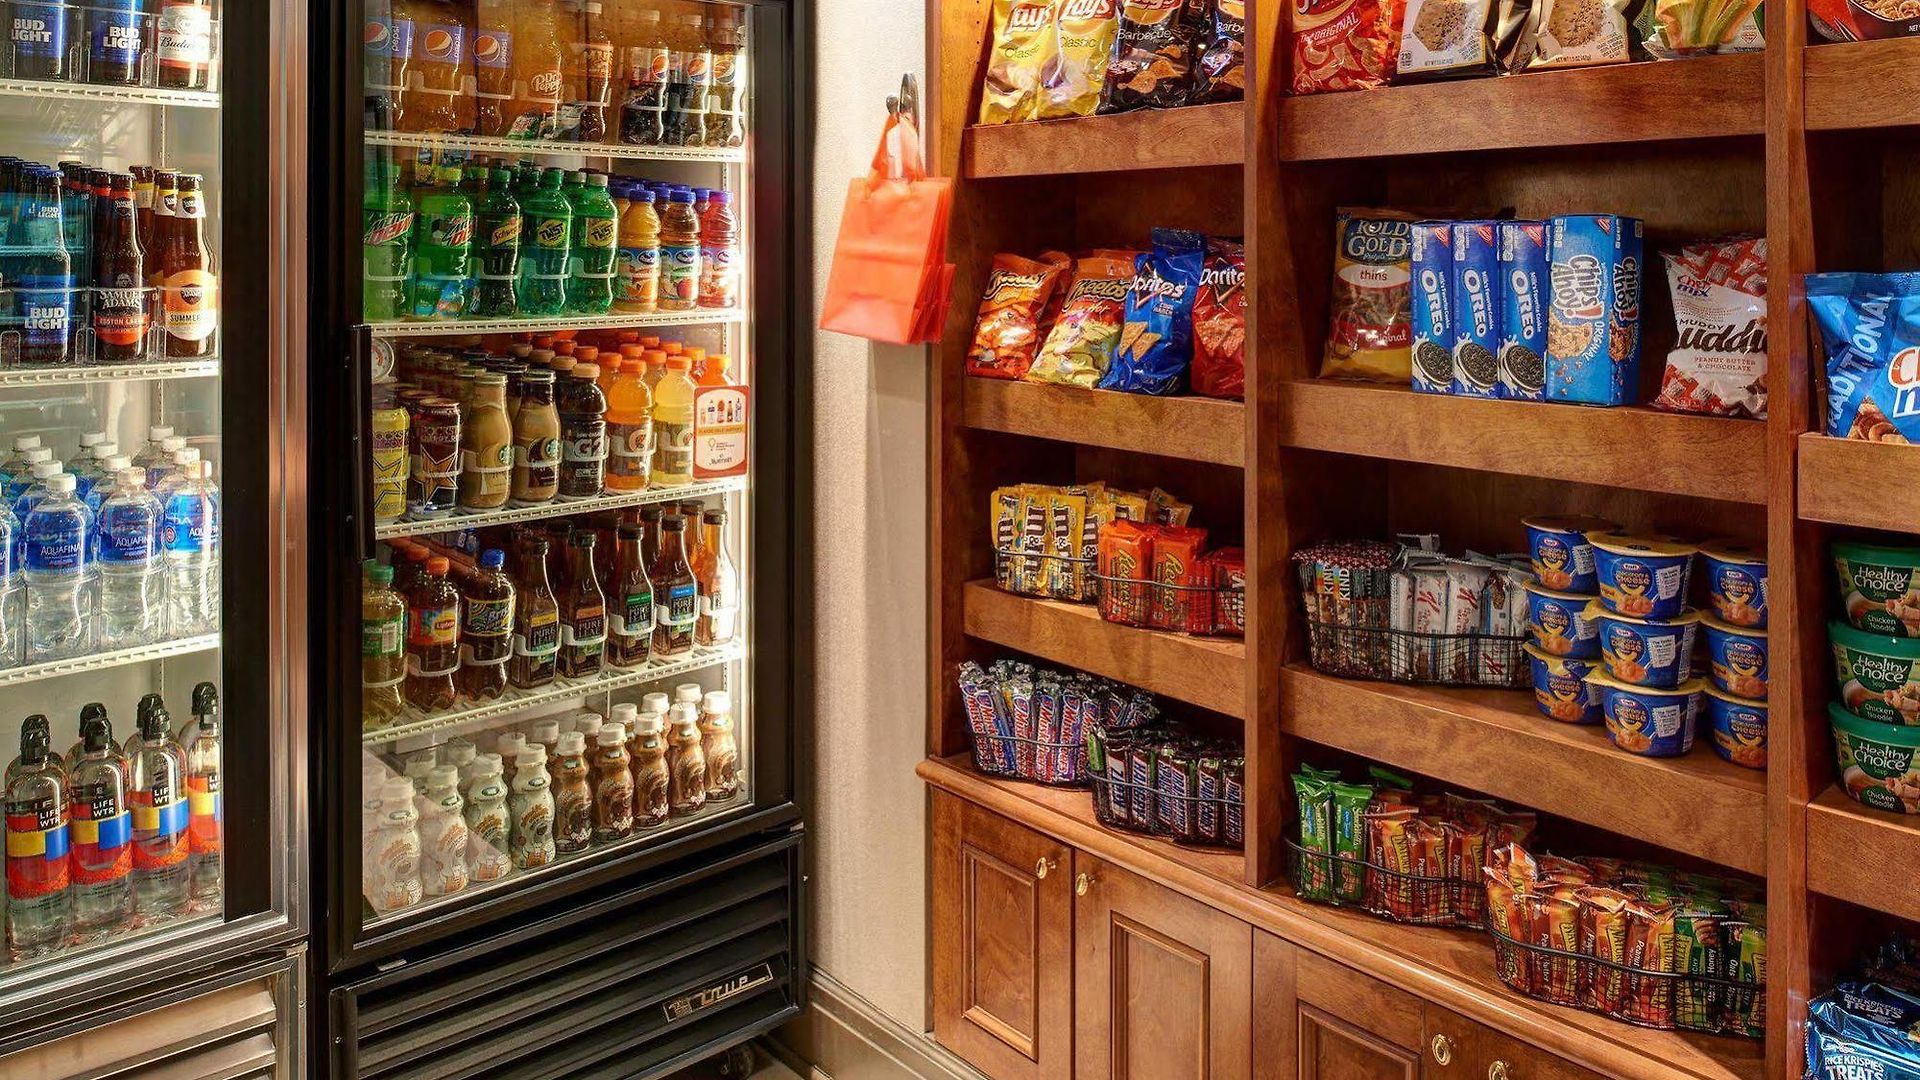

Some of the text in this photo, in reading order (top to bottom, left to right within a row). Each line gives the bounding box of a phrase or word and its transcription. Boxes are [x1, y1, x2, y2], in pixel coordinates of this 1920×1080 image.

[13, 18, 46, 31] BUD
[109, 26, 140, 39] BUD
[1313, 12, 1359, 41] ORIGINAL
[11, 28, 52, 42] LIGHT
[392, 25, 400, 52] pepsi
[1117, 27, 1171, 41] Barbecue
[103, 37, 142, 51] LIGHT
[534, 76, 560, 92] Pepper
[1356, 219, 1410, 236] ROLD
[1347, 235, 1412, 257] GOLD
[1199, 268, 1245, 287] Dorito
[1359, 269, 1388, 281] thins
[1569, 255, 1602, 308] Chips
[1622, 256, 1640, 307] Chips
[100, 289, 145, 301] SAMUEL
[1421, 269, 1443, 336] OREO
[1463, 268, 1487, 338] OREO
[102, 299, 142, 310] ADAMS
[1511, 269, 1535, 340] OREO
[30, 307, 65, 320] BUD
[170, 313, 201, 322] SUMME
[25, 317, 69, 330] LIGHT
[1679, 319, 1724, 331] MUDDY
[1582, 320, 1605, 363] ORIGINAL
[1676, 319, 1767, 355] uddi
[1695, 356, 1756, 366] PEANUT BUTTER
[1705, 363, 1751, 372] CHOCOLATE
[1826, 291, 1895, 436] RADITIONAL
[115, 537, 157, 548] AQUAFIN
[1323, 562, 1335, 594] KIND
[1854, 573, 1905, 593] Choice
[1859, 566, 1909, 584] Healthy
[1338, 568, 1351, 600] KIND
[1867, 614, 1897, 626] Chicken
[1869, 622, 1897, 633] Noodle
[1858, 654, 1909, 673] Healthy
[1852, 663, 1905, 684] Choice
[1864, 703, 1894, 716] Chicken
[1860, 742, 1910, 761] Healthy
[1854, 749, 1906, 772] Choice
[153, 795, 170, 805] WT
[154, 787, 170, 797] LIF
[1866, 789, 1896, 802] Chicken
[93, 799, 115, 809] LIFE
[93, 806, 115, 817] WTR
[39, 816, 61, 828] WTR
[1633, 939, 1645, 970] Peanut
[1707, 948, 1717, 973] Honey
[1728, 959, 1739, 977] Oats
[1845, 1000, 1902, 1019] TREATS
[1825, 1055, 1885, 1073] RICE KRISPIES
[1825, 1065, 1884, 1080] TREATS
